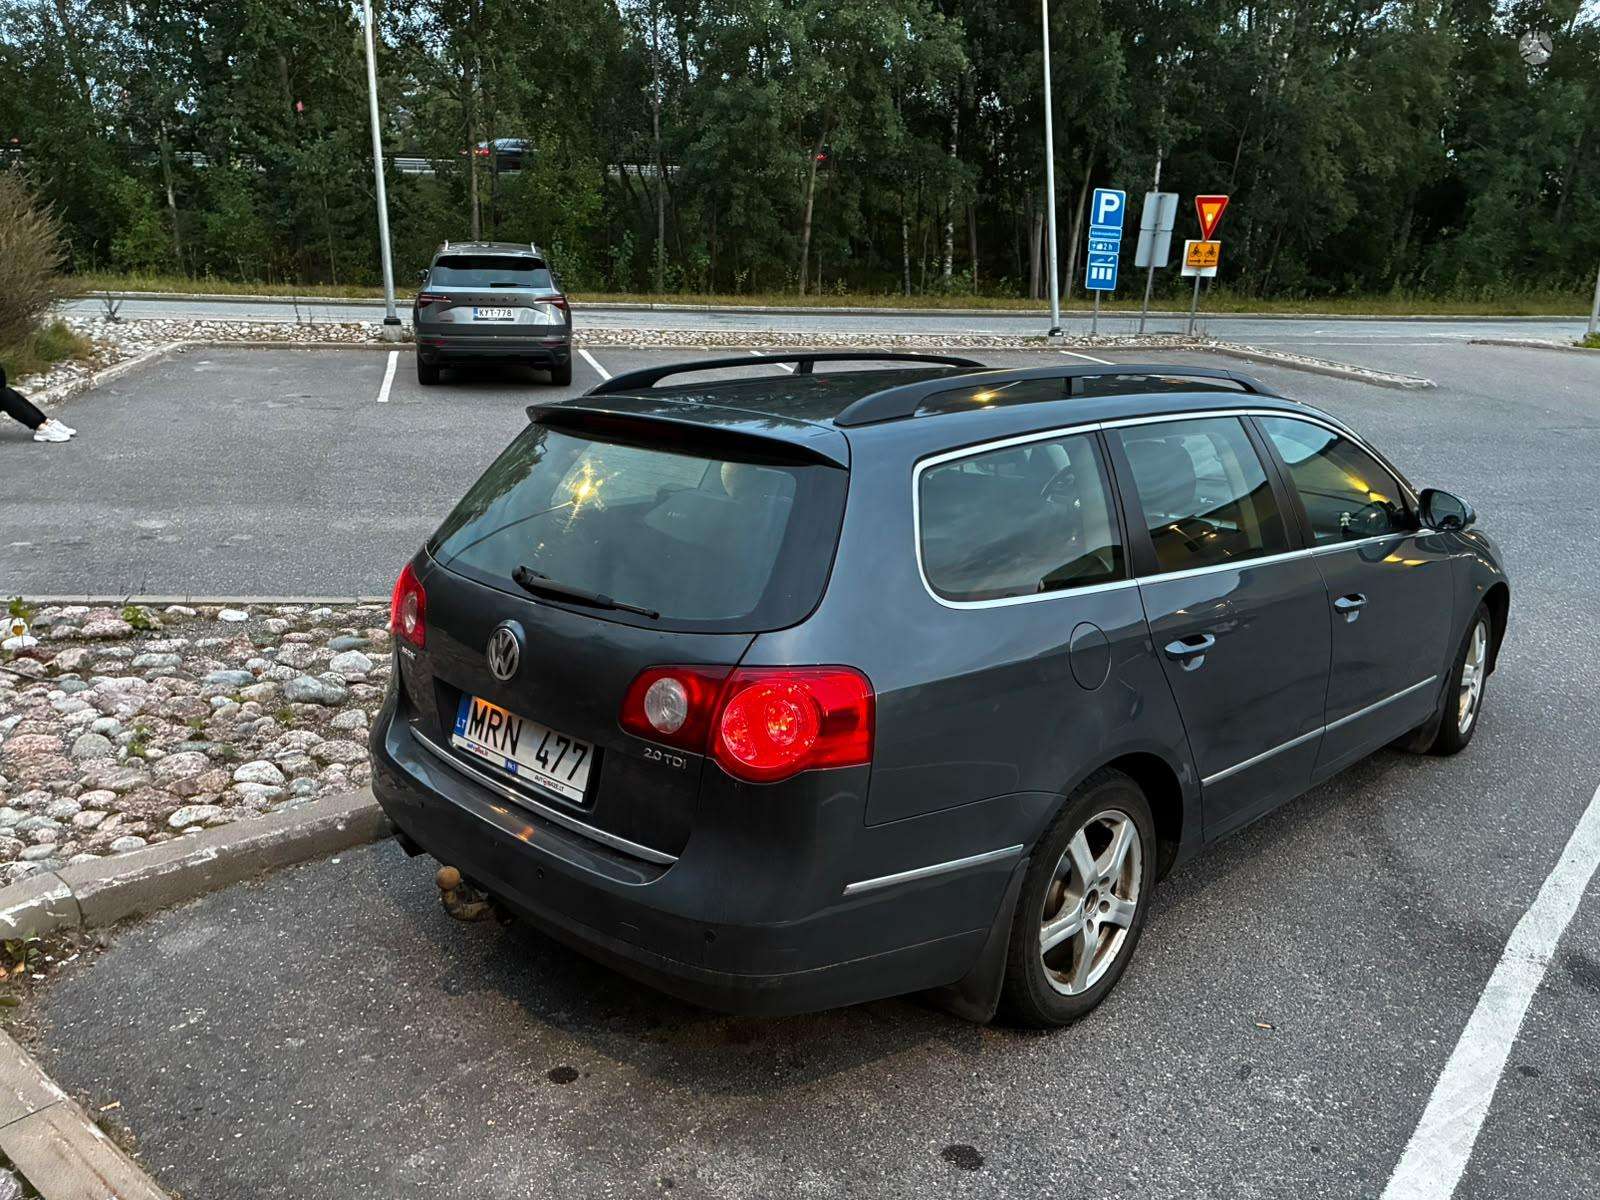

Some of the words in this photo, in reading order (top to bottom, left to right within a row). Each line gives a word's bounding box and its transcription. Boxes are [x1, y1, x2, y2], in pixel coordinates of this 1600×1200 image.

[1098, 193, 1120, 223] P
[479, 309, 512, 317] KYT-778
[457, 717, 467, 729] LT
[468, 700, 523, 757] MRN
[535, 730, 589, 781] 477
